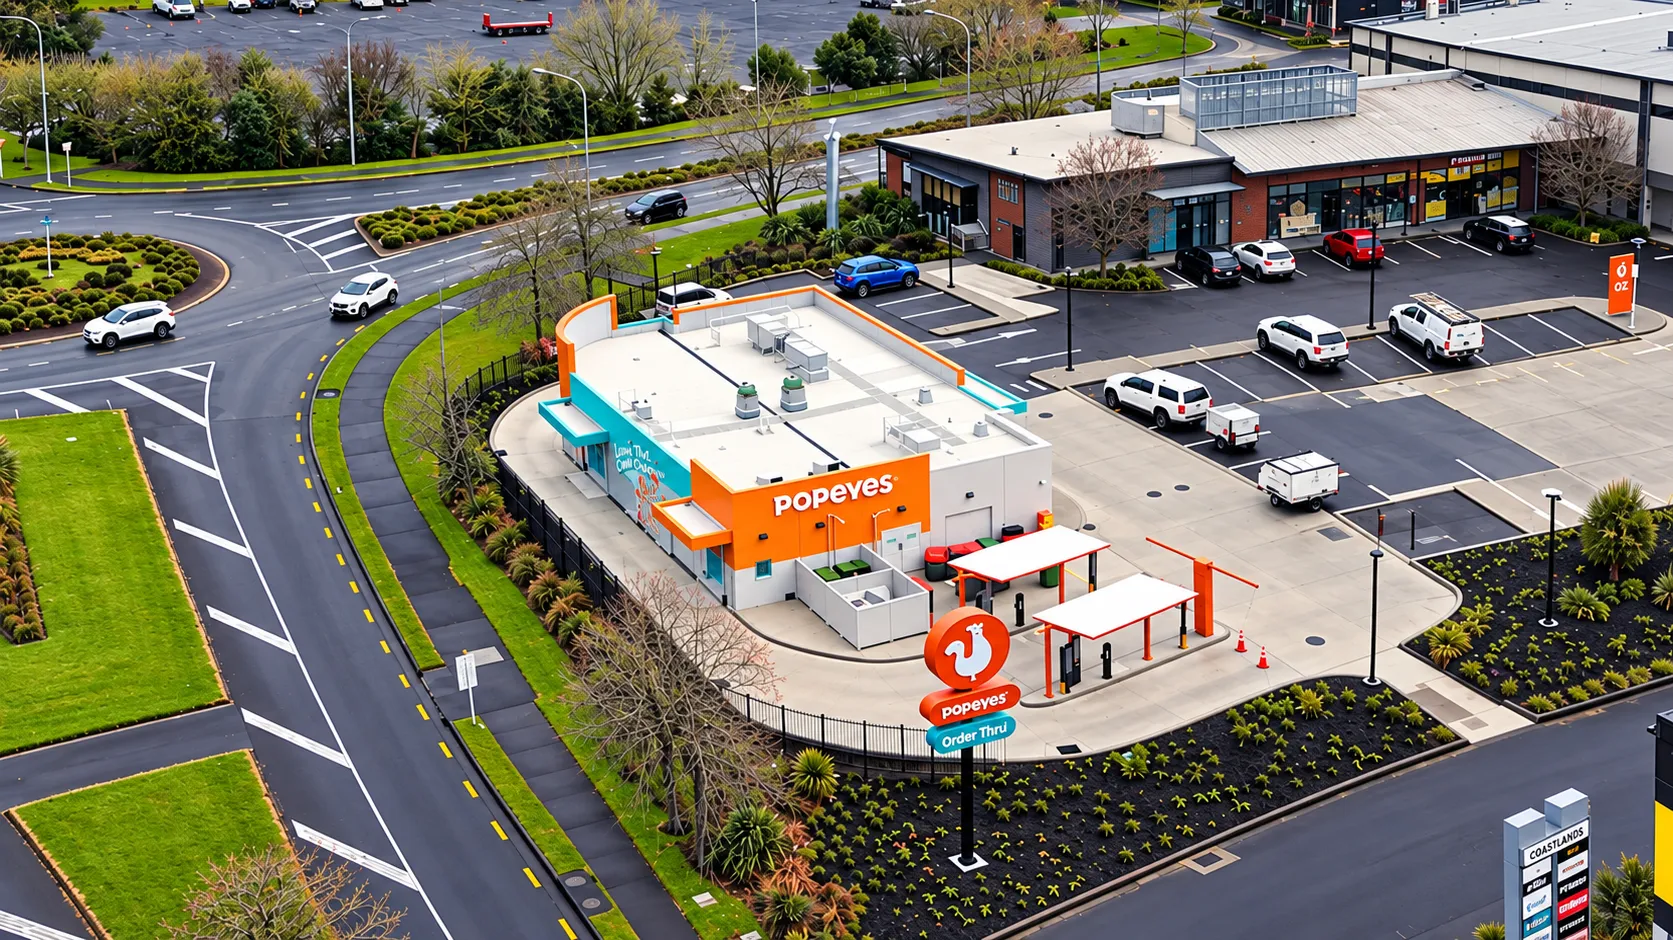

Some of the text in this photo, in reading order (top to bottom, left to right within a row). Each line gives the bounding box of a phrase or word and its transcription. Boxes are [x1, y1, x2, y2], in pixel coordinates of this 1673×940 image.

[1614, 281, 1629, 292] OZ
[942, 721, 1008, 748] Order Thru
[1529, 827, 1584, 860] COASTLANDS
